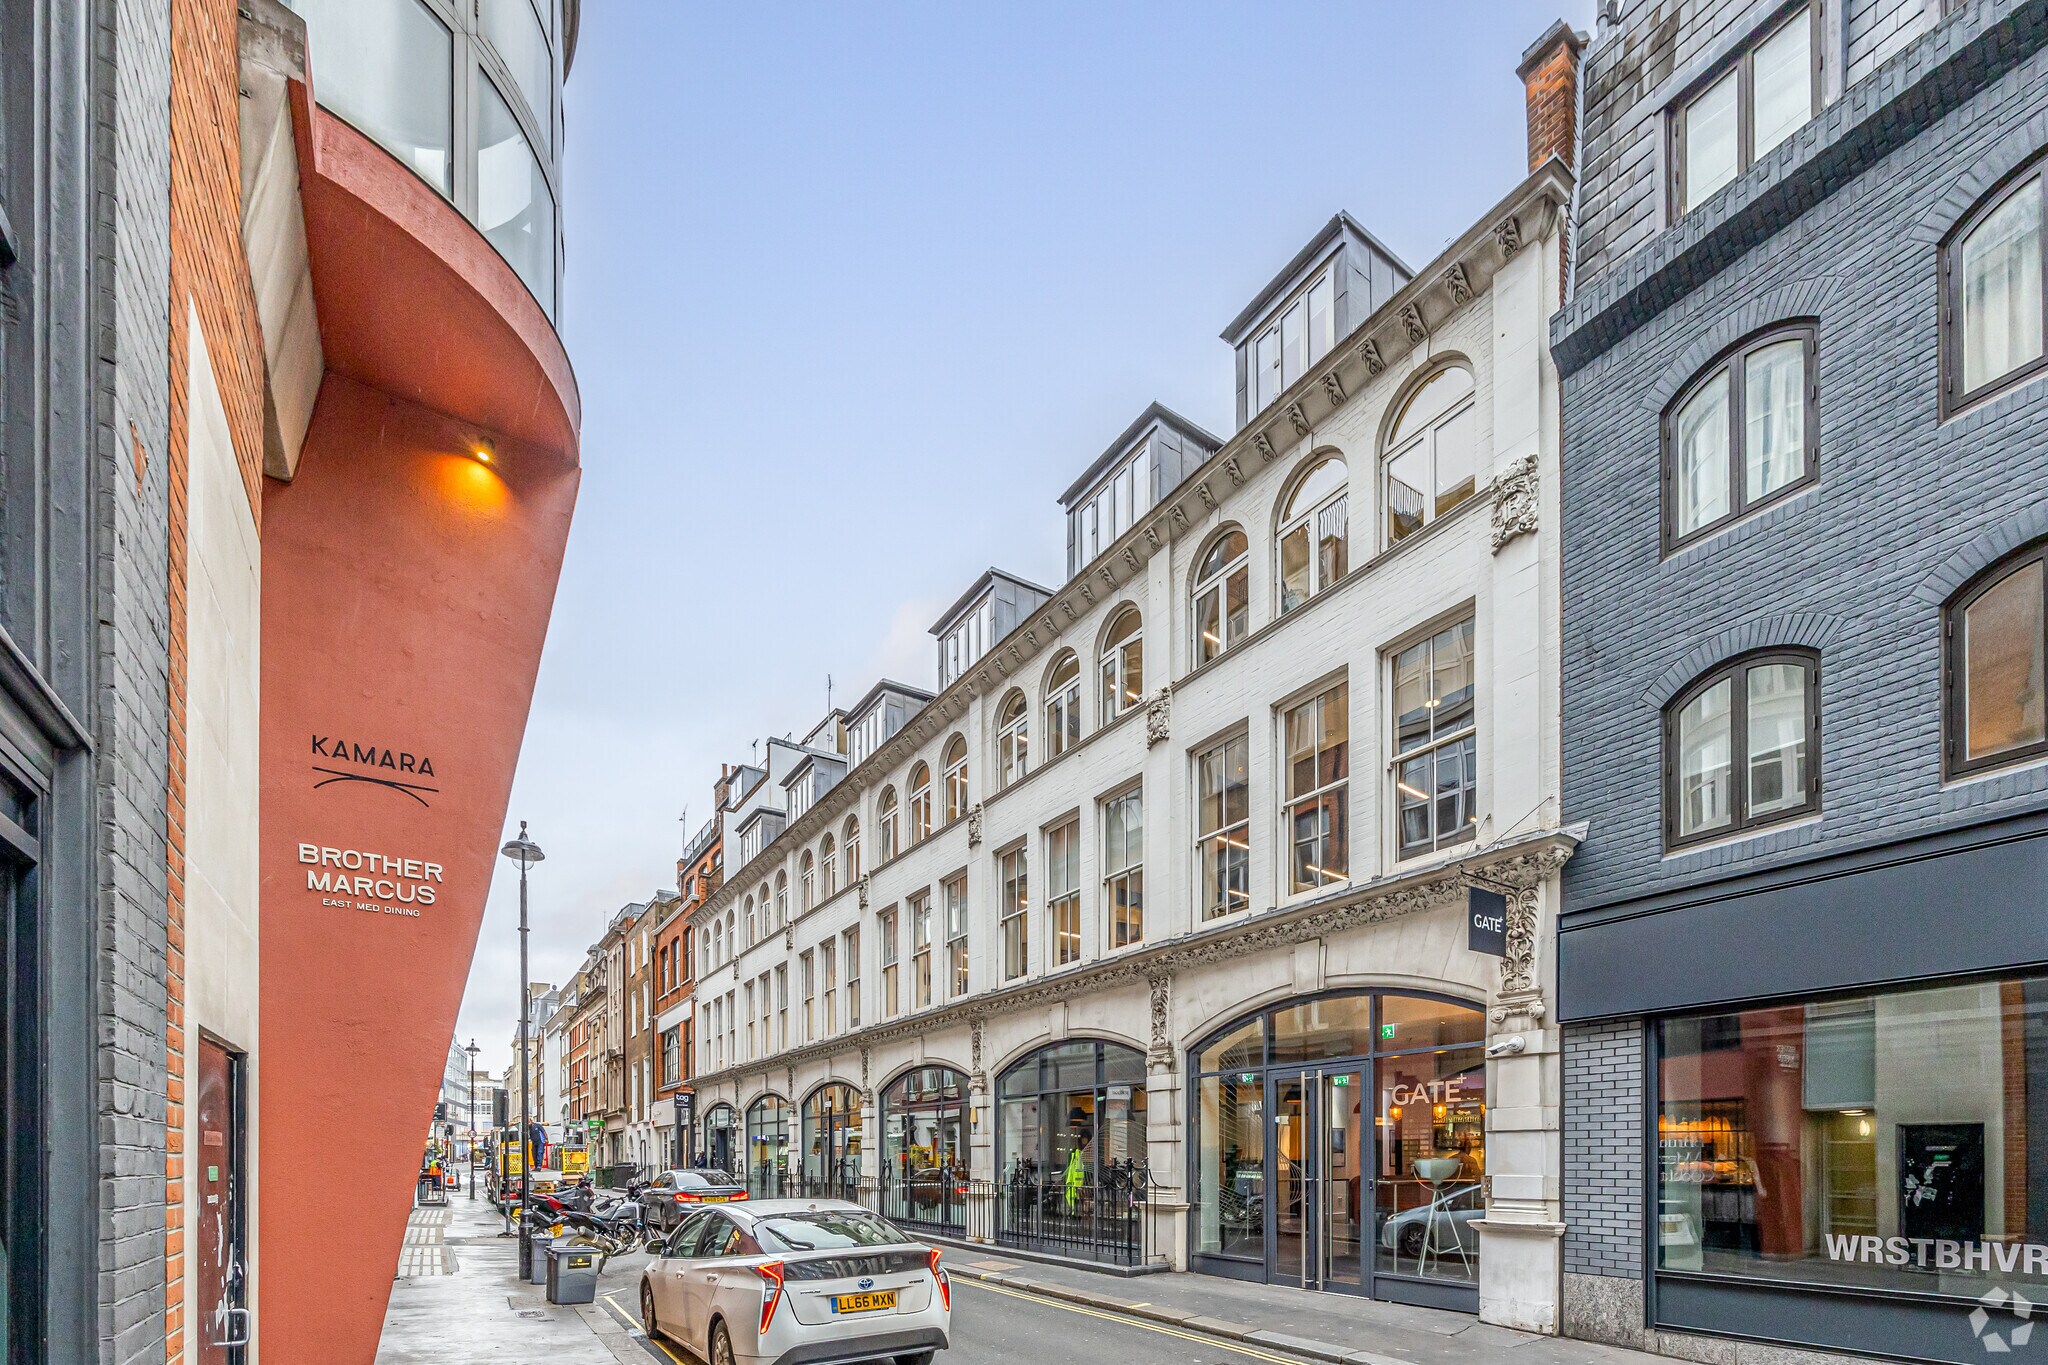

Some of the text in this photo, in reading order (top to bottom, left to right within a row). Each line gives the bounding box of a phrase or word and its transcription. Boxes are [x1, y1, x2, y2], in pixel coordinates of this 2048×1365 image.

[311, 734, 436, 777] KAMARA
[298, 843, 443, 883] BROTHER
[307, 869, 437, 905] MARCUS
[322, 898, 420, 917] EAST MED DINING
[1825, 1233, 2048, 1275] WRSTBHVR
[839, 1294, 894, 1310] LL66 MXN
